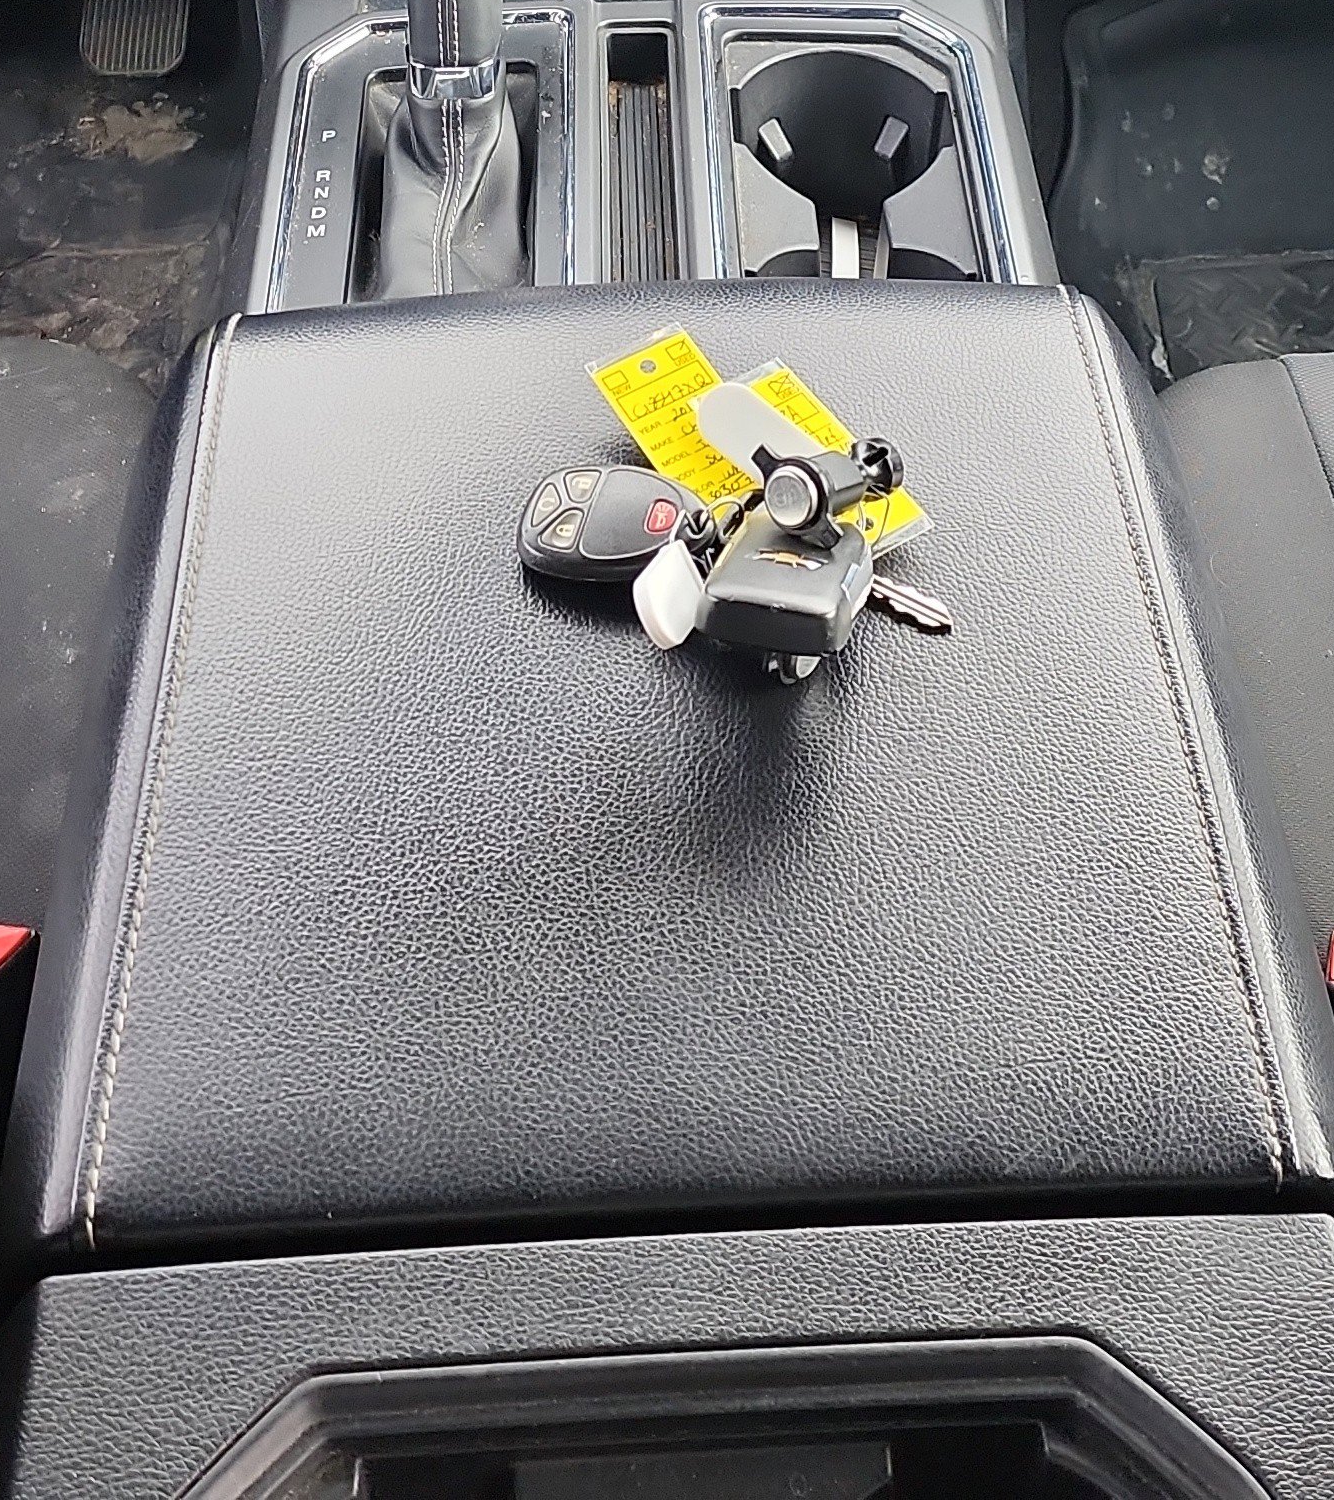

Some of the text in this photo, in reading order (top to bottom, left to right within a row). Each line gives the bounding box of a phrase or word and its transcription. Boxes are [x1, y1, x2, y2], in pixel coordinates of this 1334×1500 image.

[321, 130, 336, 142] P
[315, 170, 331, 182] R
[314, 186, 329, 199] N
[311, 206, 327, 219] D
[307, 224, 326, 237] M
[672, 403, 693, 422] 201
[638, 421, 662, 436] YEAR
[650, 437, 674, 451] MAKE
[661, 451, 691, 468] MODEL
